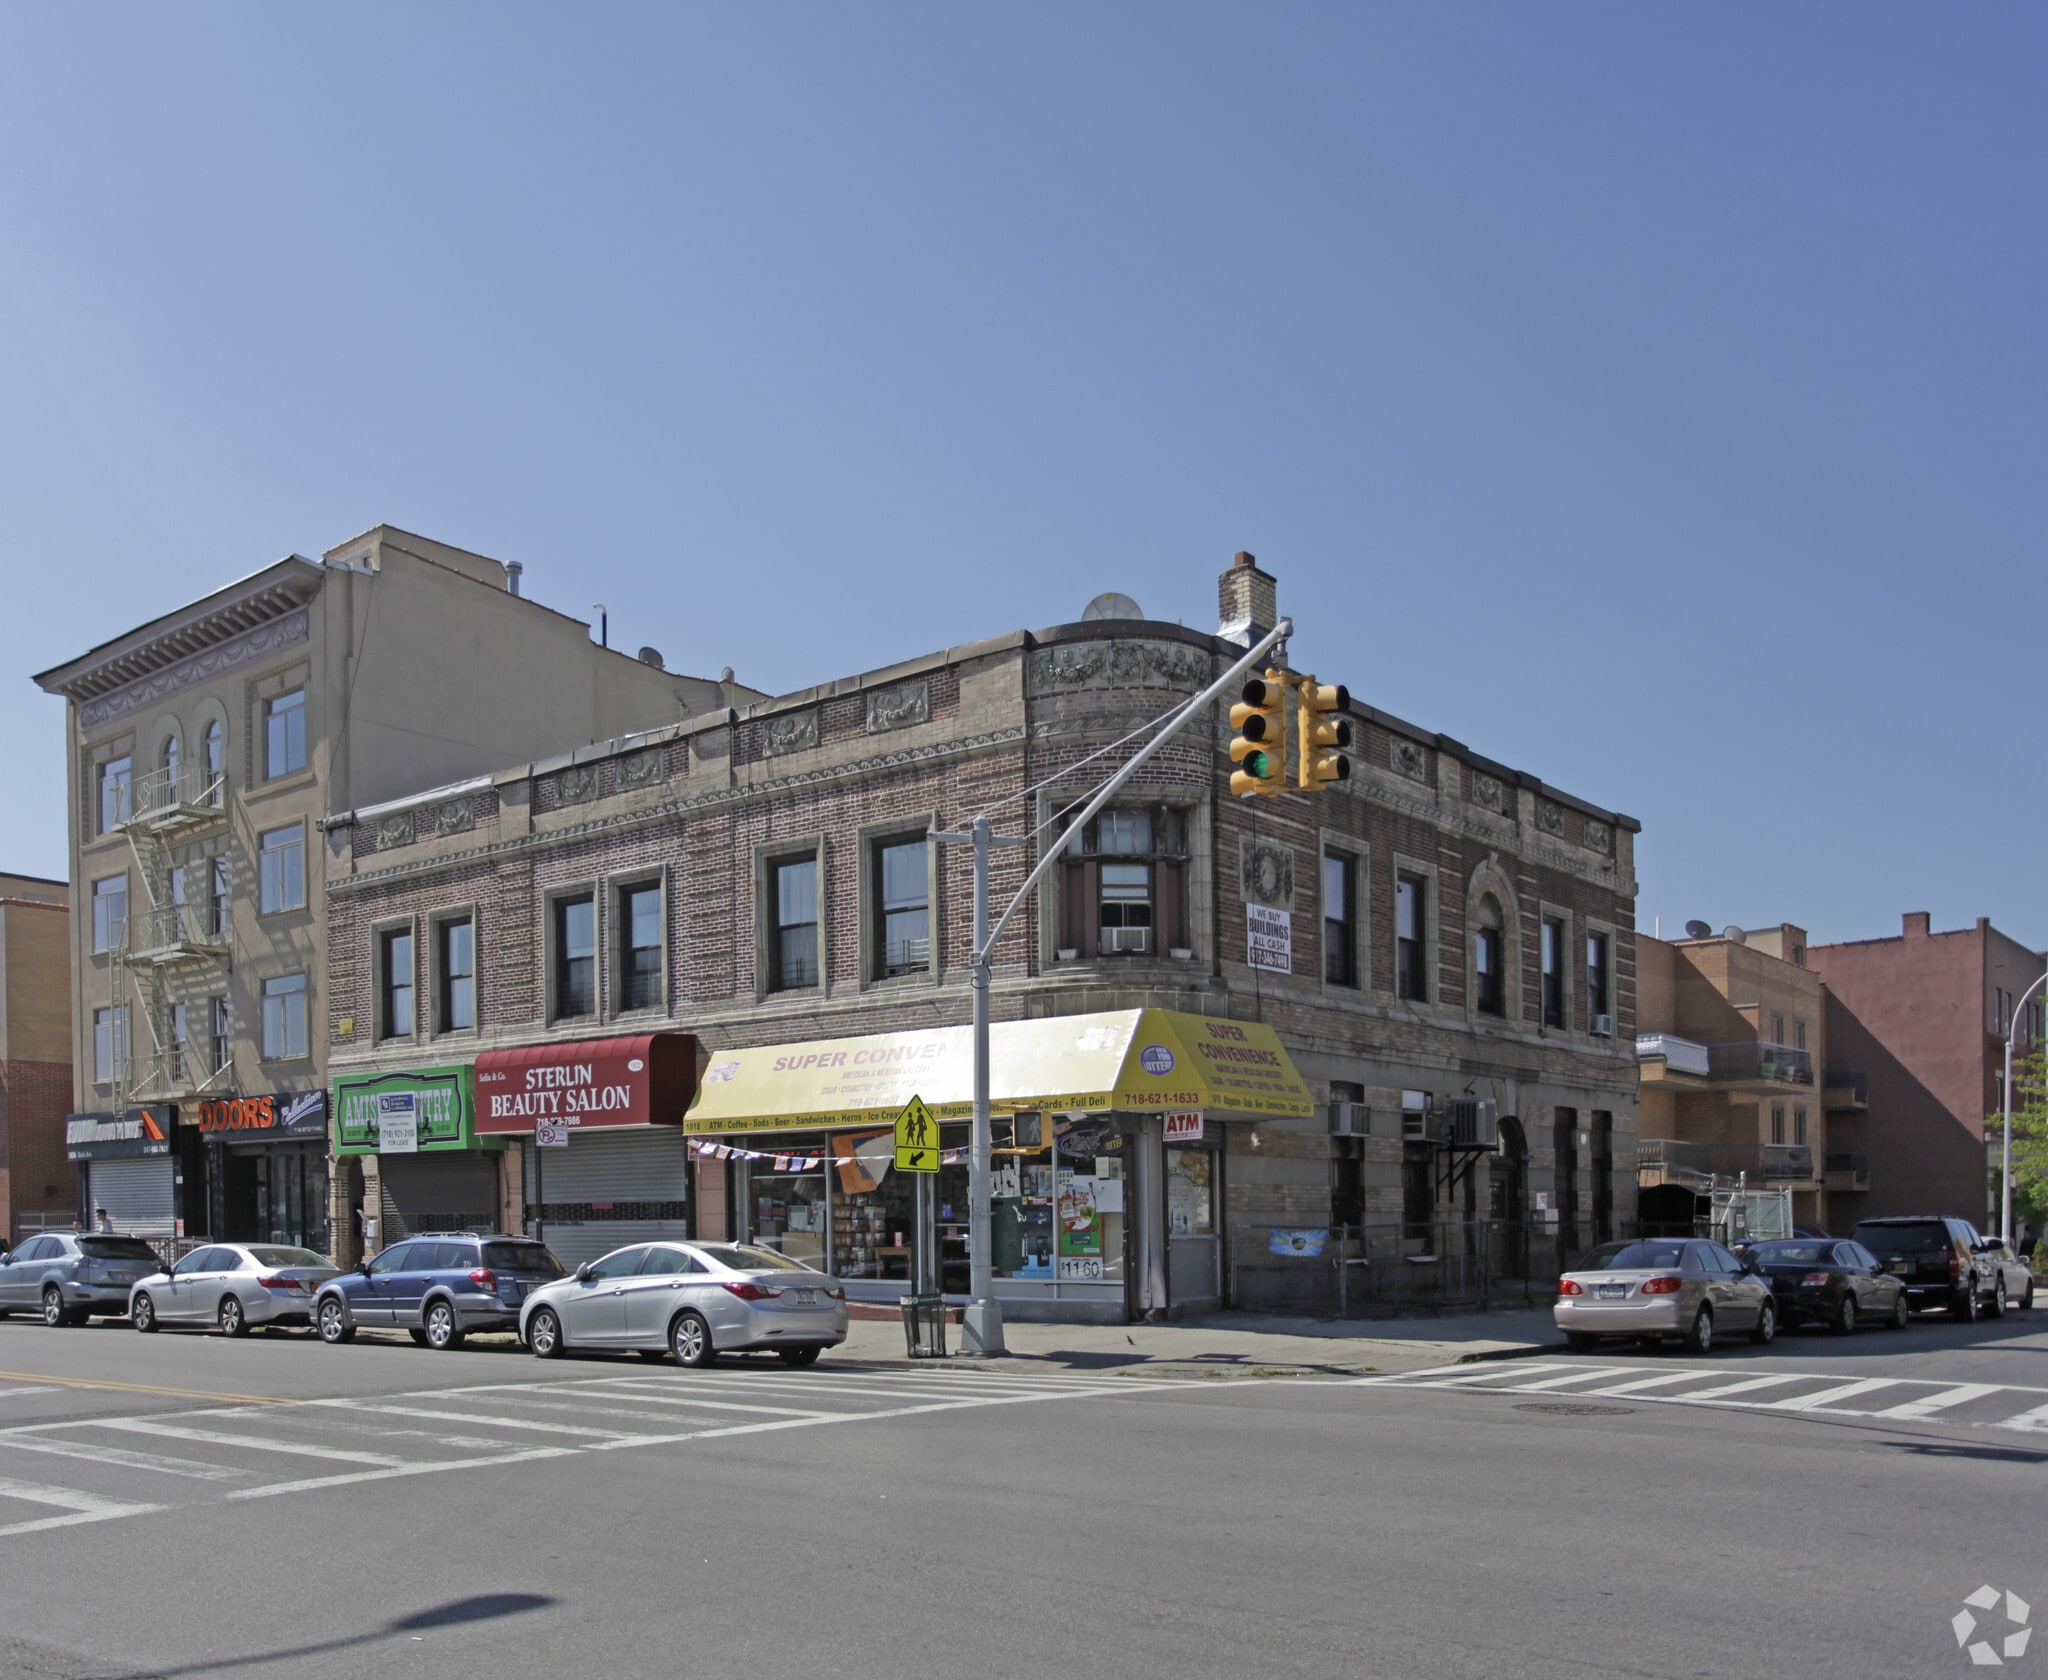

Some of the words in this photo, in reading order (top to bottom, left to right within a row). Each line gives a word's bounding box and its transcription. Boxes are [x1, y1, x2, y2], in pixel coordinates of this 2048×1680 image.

[1257, 908, 1266, 919] WE
[1269, 912, 1280, 921] BUY
[1249, 918, 1288, 940] BUILDINGS
[1254, 936, 1265, 947] ALL
[1268, 939, 1285, 951] CASH
[1205, 1022, 1248, 1042] SUPER
[773, 1051, 847, 1072] SUPER
[853, 1042, 949, 1066] CONVEN
[1197, 1042, 1281, 1067] CONVENIENCE
[526, 1063, 592, 1089] STERLIN
[345, 1094, 379, 1127] AMIS
[414, 1088, 452, 1122] NTRY
[491, 1091, 562, 1118] BEAUTY
[566, 1085, 630, 1112] SALON
[1125, 1093, 1199, 1105] 718-621-1633
[199, 1096, 273, 1132] DOORS
[686, 1122, 700, 1131] 1818
[709, 1121, 723, 1130] ATM
[727, 1120, 748, 1129] Coffee
[753, 1118, 769, 1127] Soda
[775, 1117, 790, 1127] Beer
[795, 1114, 836, 1125] Sandwiches
[842, 1113, 861, 1122] Heros
[868, 1112, 879, 1121] Ice
[881, 1110, 901, 1120] Crea
[941, 1105, 973, 1117] Magazin
[1039, 1100, 1062, 1110] Cards
[1071, 1096, 1086, 1107] Full
[1089, 1095, 1106, 1106] Deli
[1167, 1113, 1199, 1133] ATM
